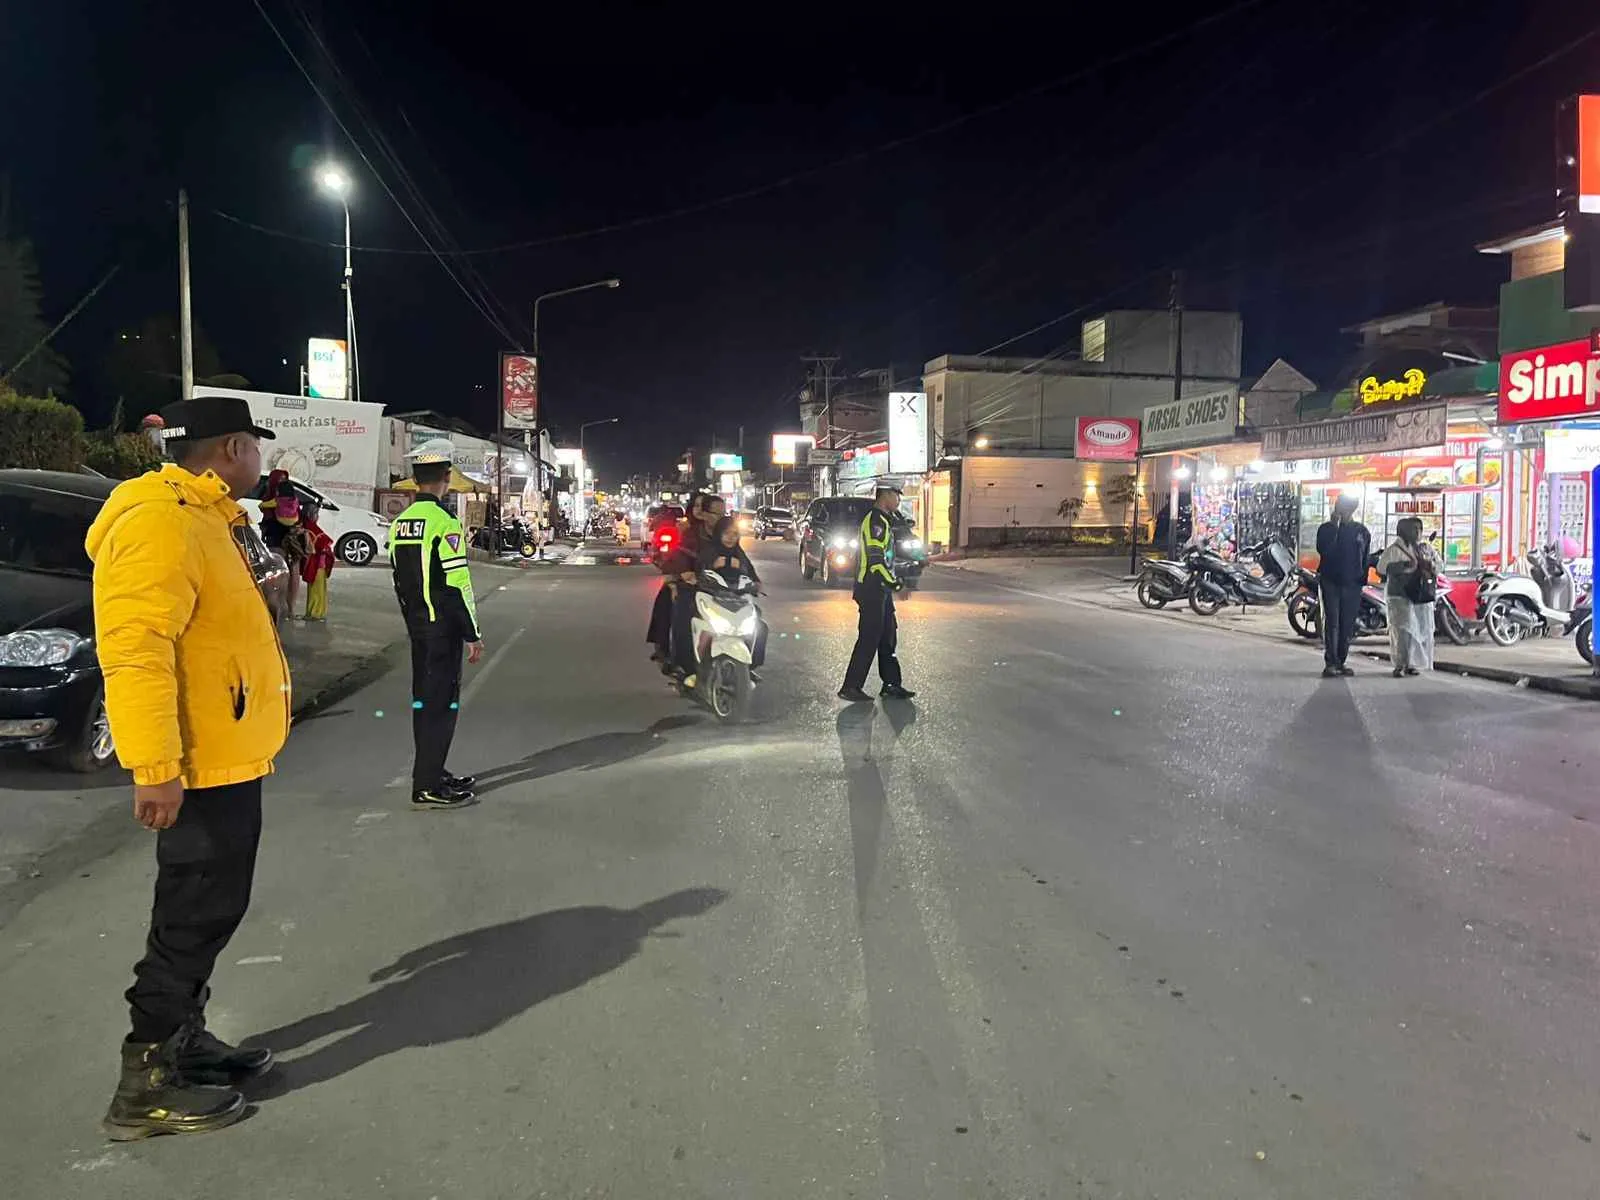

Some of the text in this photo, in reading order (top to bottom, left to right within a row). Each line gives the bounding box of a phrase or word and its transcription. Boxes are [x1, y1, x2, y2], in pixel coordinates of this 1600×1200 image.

[1147, 394, 1229, 433] ARSAL SHOES
[1090, 427, 1127, 440] Amanda
